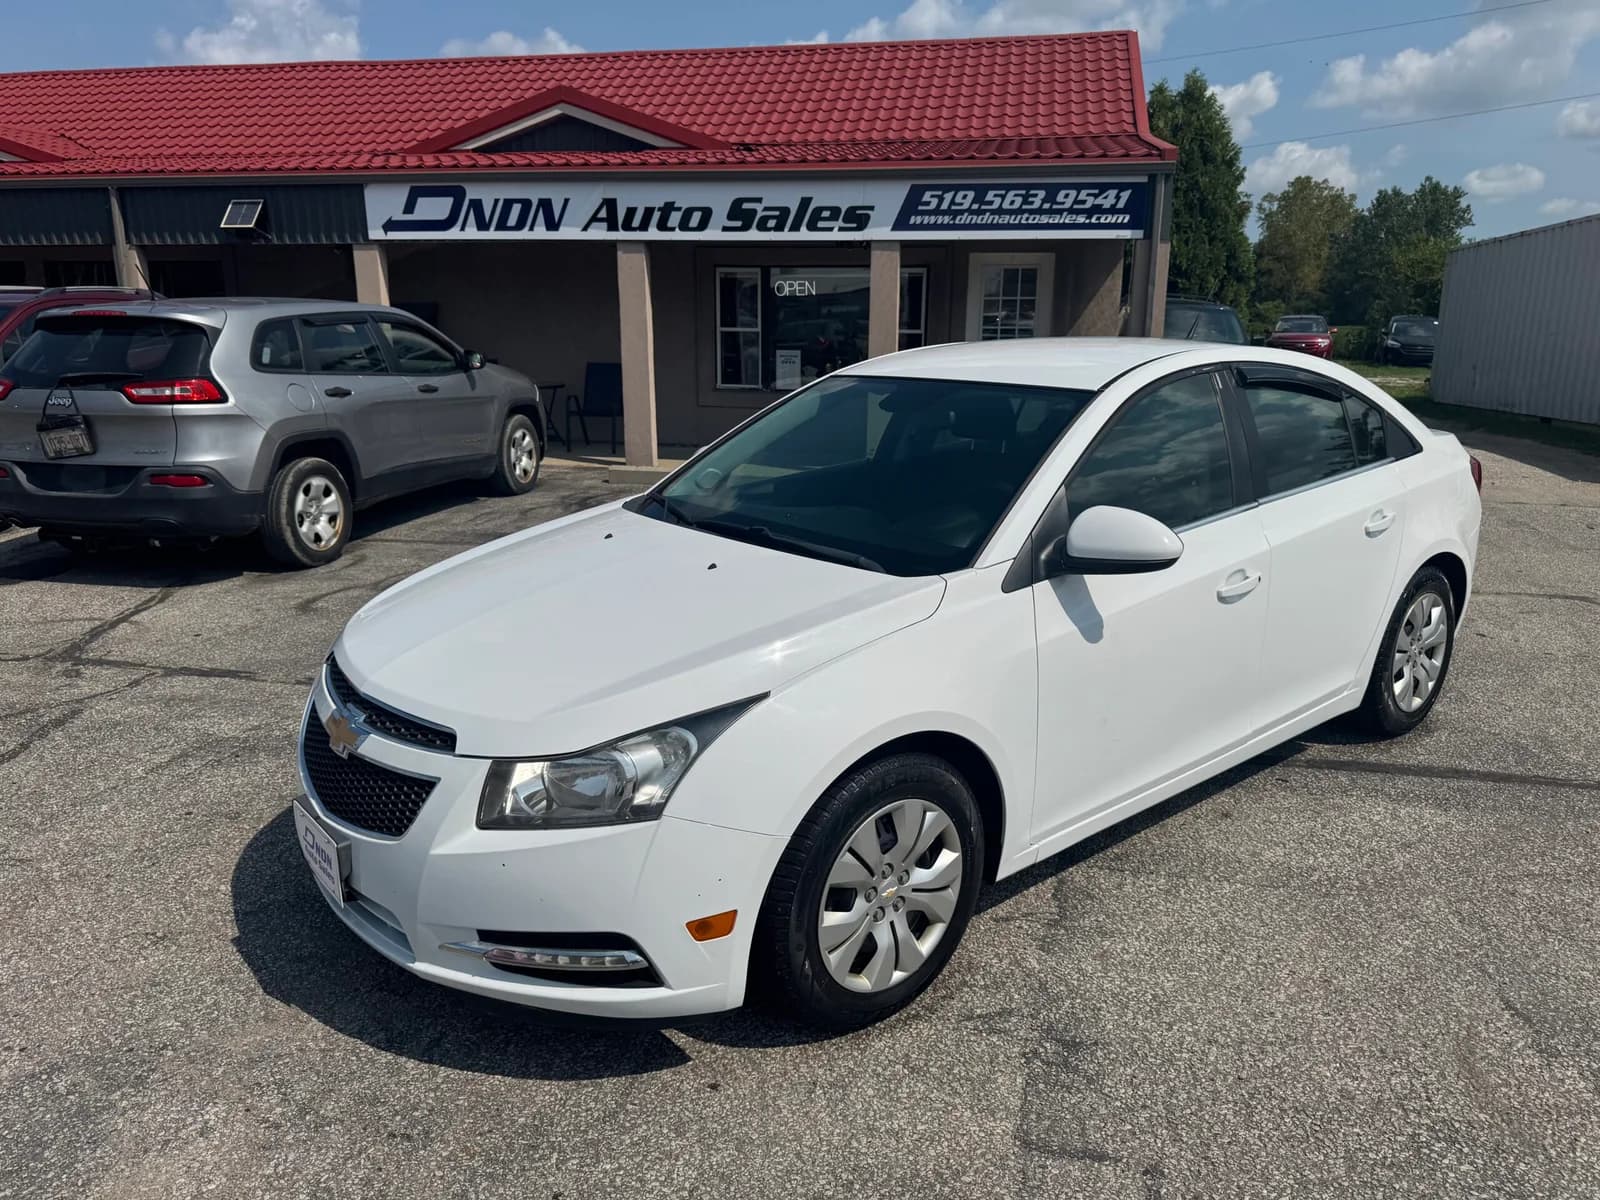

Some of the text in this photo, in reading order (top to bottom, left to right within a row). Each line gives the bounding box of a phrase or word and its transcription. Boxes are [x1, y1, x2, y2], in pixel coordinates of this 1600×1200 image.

[917, 189, 1132, 210] 519.563.9541
[381, 185, 875, 236] DNDN Auto Sales
[909, 212, 1131, 225] www.dndnautosales.com
[774, 280, 816, 297] OPEN
[48, 395, 73, 407] Jeep
